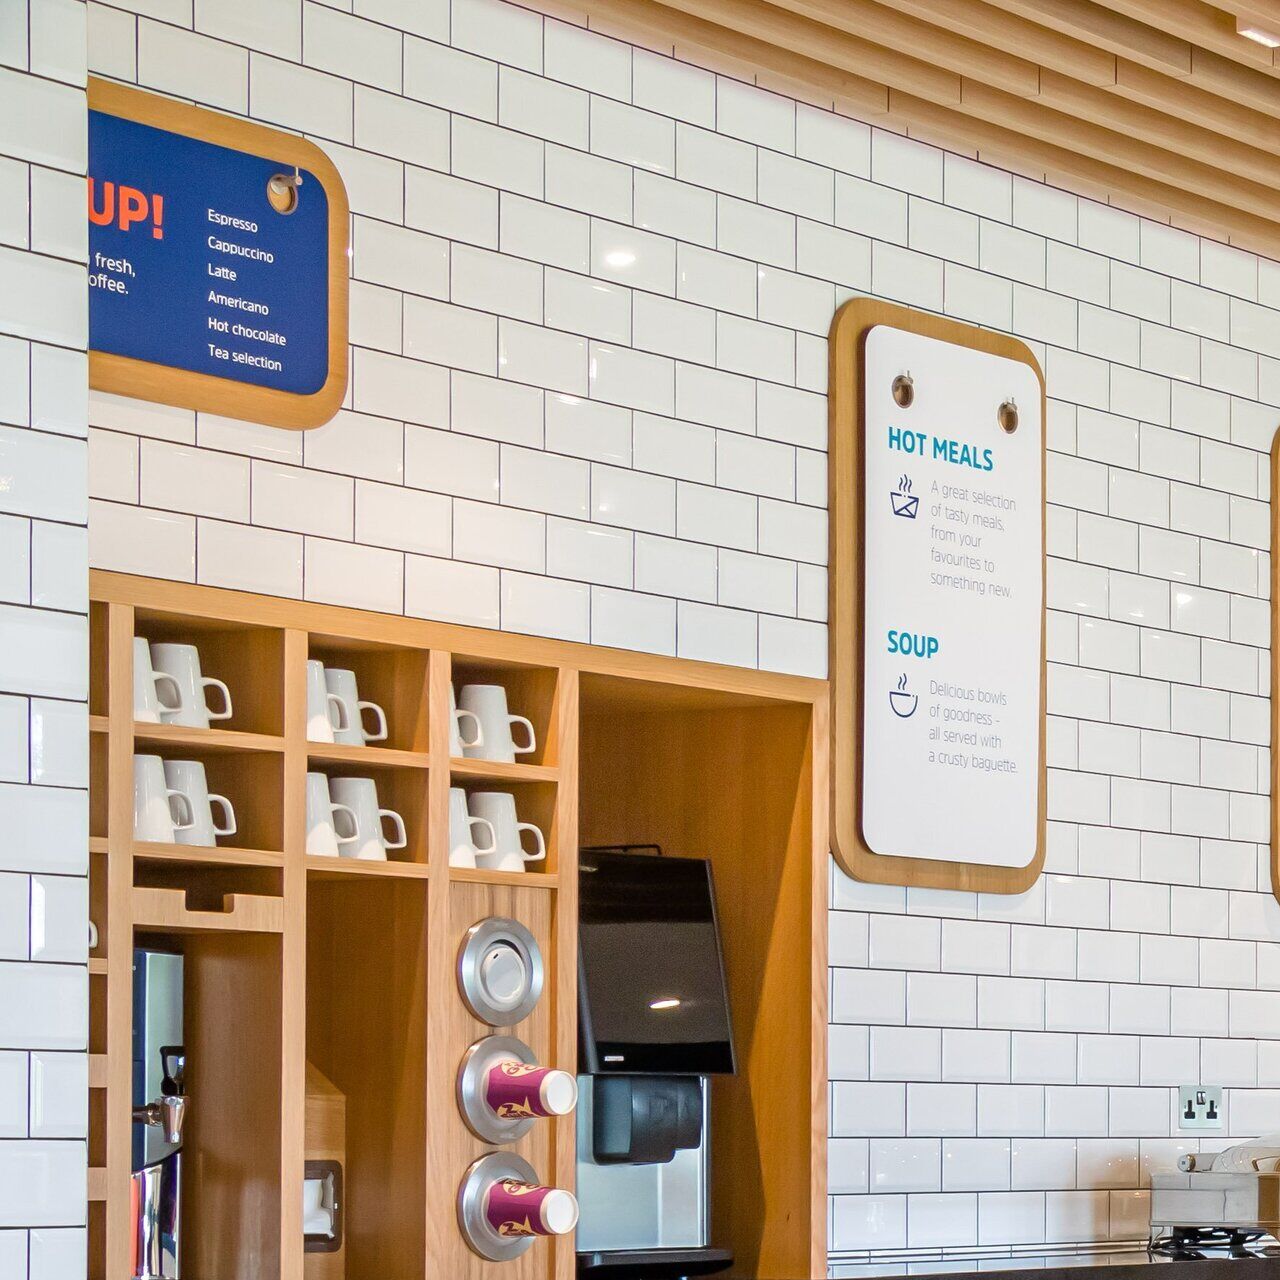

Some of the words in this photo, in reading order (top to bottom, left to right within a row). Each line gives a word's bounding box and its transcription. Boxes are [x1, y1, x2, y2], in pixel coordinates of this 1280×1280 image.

[88, 177, 163, 240] UP!
[207, 208, 259, 233] Espresso
[207, 235, 275, 264] Cappuccino
[95, 252, 136, 278] fresh,
[207, 262, 238, 282] Latte
[88, 273, 129, 295] offee.
[207, 290, 269, 316] Americano
[207, 316, 229, 334] Hot
[231, 323, 287, 347] chocolate
[207, 343, 230, 360] Tea
[232, 350, 282, 372] selection
[888, 426, 927, 456] HOT
[932, 436, 994, 472] MEALS
[930, 479, 939, 495] A
[941, 483, 969, 500] great
[971, 489, 1017, 512] selection
[931, 503, 942, 517] of
[945, 505, 970, 526] tasty
[972, 512, 1005, 532] meals,
[931, 525, 956, 543] from
[959, 533, 982, 548] your
[930, 546, 981, 571] favourites
[984, 559, 995, 573] to
[930, 572, 986, 596] something
[988, 584, 1013, 599] new.
[887, 629, 939, 659] SOUP
[929, 679, 975, 701] Delicious
[977, 687, 1008, 706] bowls
[929, 703, 941, 718] of
[943, 708, 993, 726] goodness
[928, 726, 941, 741] all
[943, 729, 977, 746] served
[980, 735, 1002, 749] with
[928, 751, 935, 763] a
[938, 751, 969, 769] crusty
[971, 753, 1019, 774] baguette.
